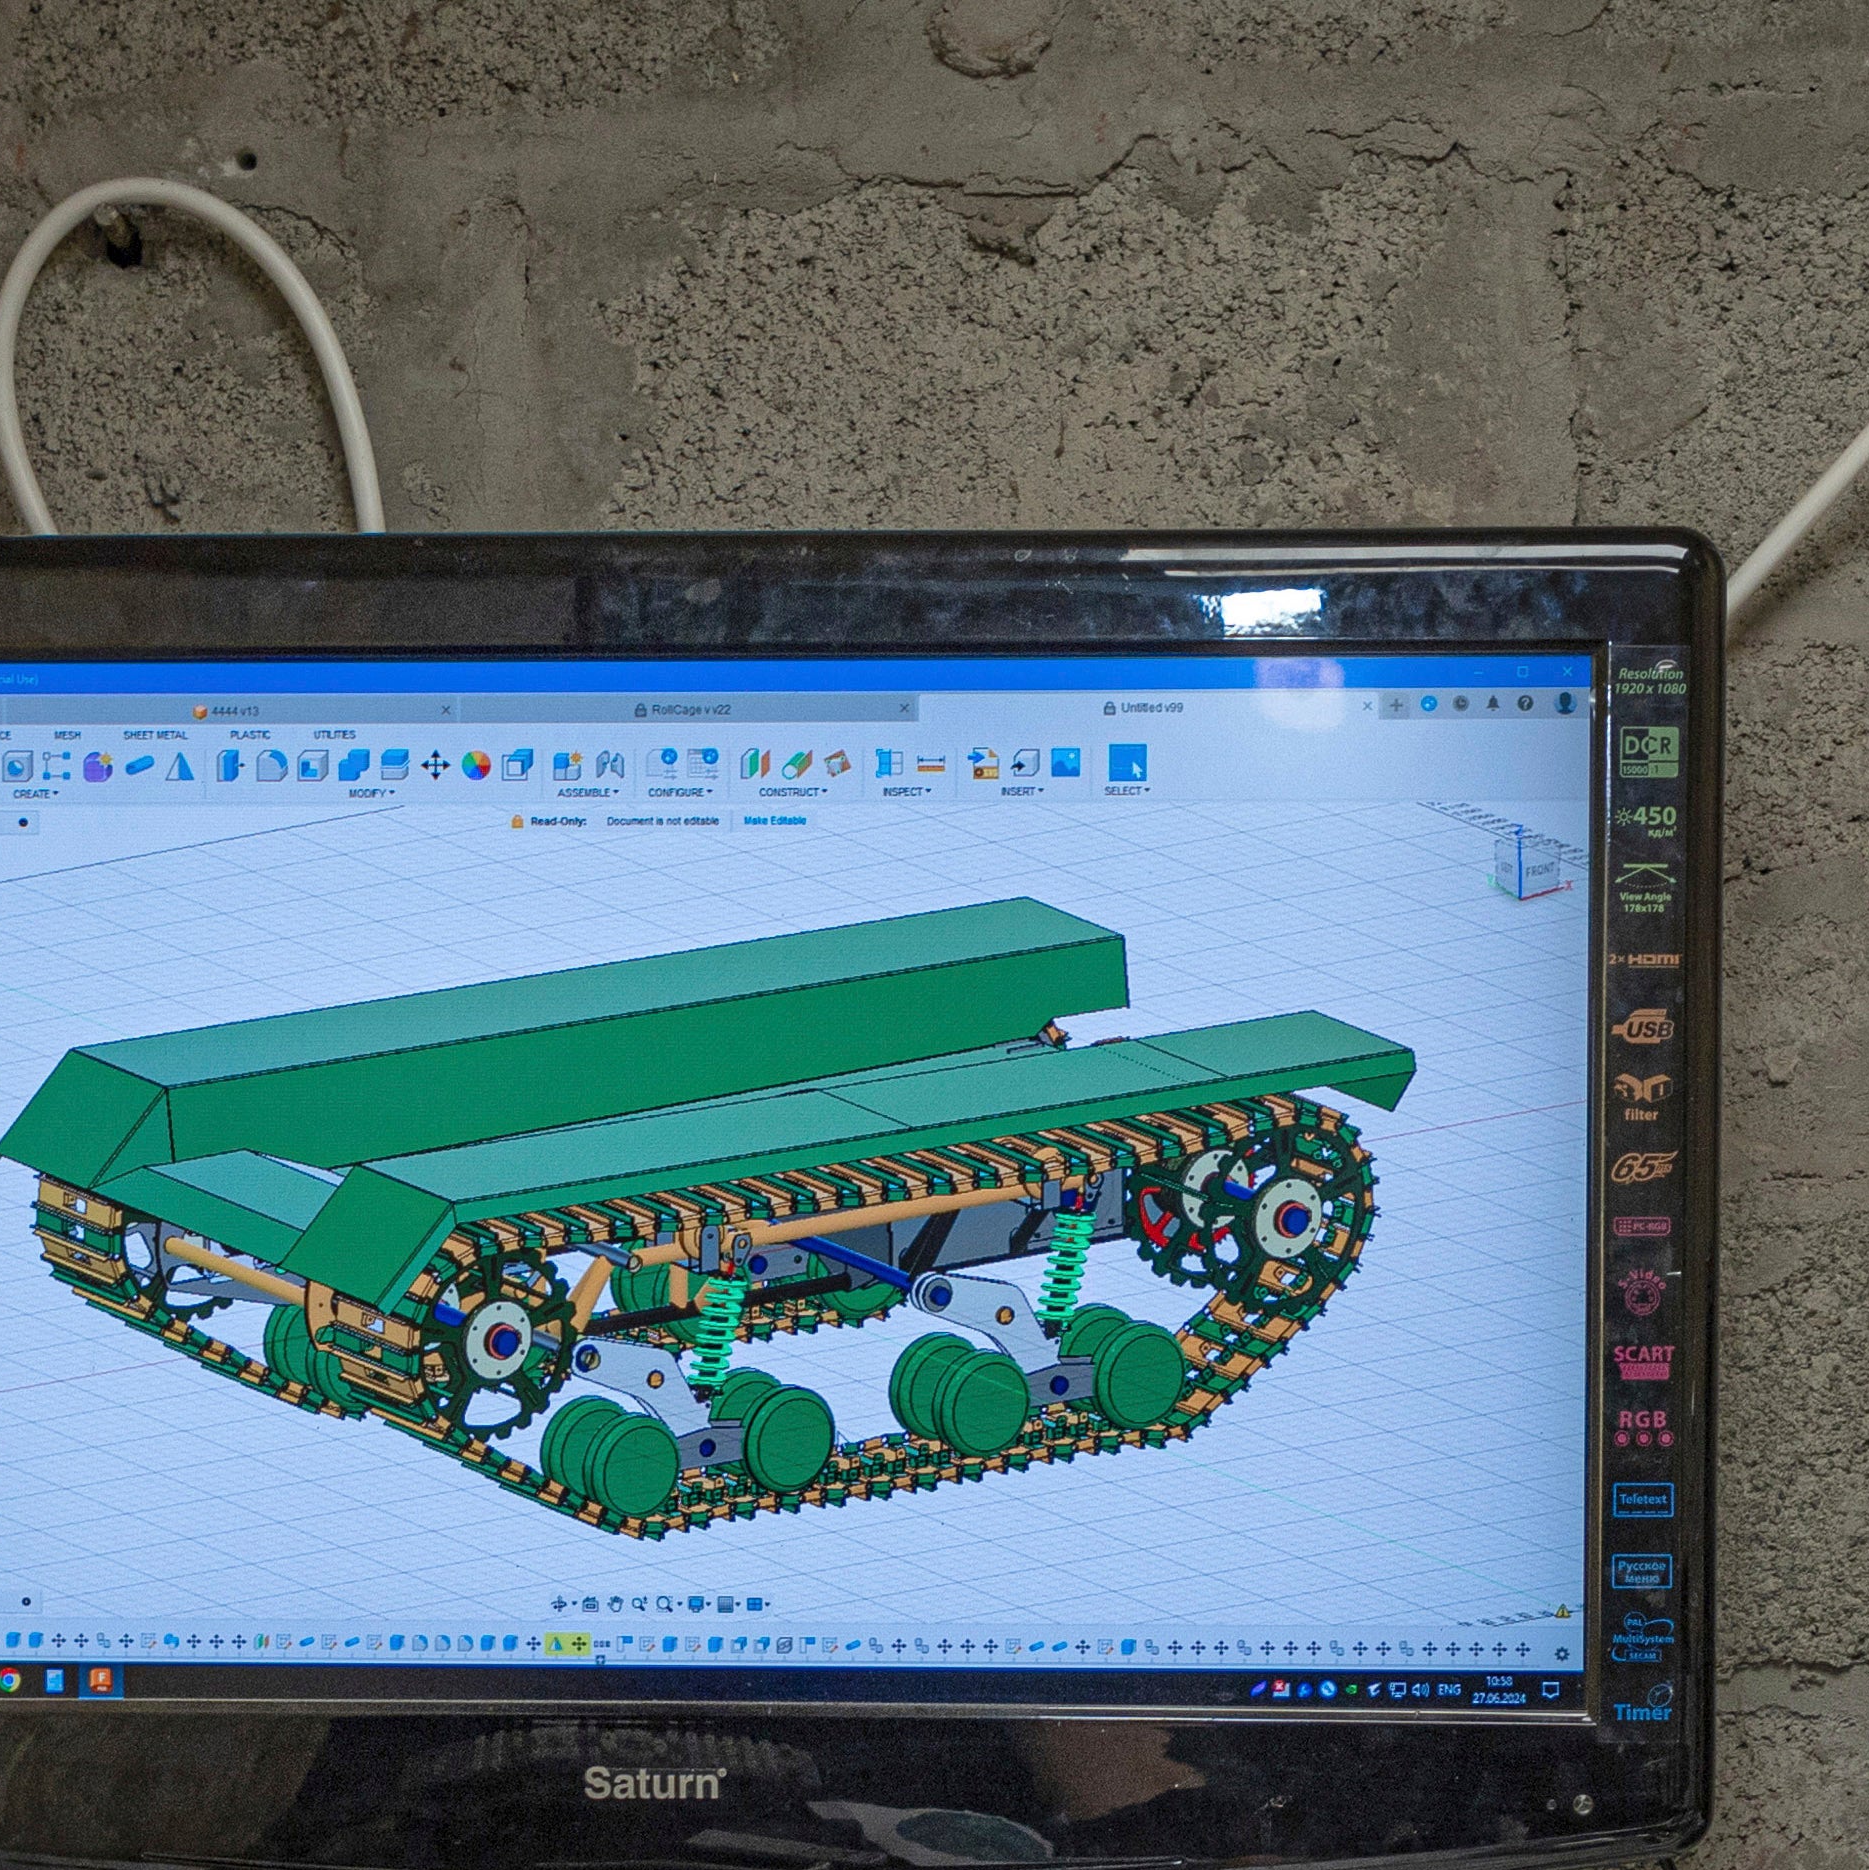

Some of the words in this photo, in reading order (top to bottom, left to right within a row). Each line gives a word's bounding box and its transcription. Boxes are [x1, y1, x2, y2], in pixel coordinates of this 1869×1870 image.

[1619, 668, 1684, 680] Resolution
[1615, 683, 1644, 694] 1920
[1646, 686, 1652, 694] x
[1658, 683, 1687, 694] 1080
[212, 706, 237, 716] 4444
[240, 706, 260, 716] v13
[652, 704, 702, 716] RollCage
[712, 705, 731, 715] v22
[1121, 702, 1162, 713] Untitled
[1164, 703, 1184, 713] v99
[55, 731, 81, 741] MESH
[124, 730, 154, 740] SHEET
[157, 730, 188, 740] METAL
[230, 730, 270, 740] PLASTIC
[314, 730, 356, 740] UTILITIES
[1625, 736, 1672, 754] DCR
[14, 789, 50, 800] CREATE
[350, 788, 385, 798] MODIFY
[558, 788, 611, 798] ASSEMBLE
[648, 788, 704, 798] CONFIGURE
[760, 788, 820, 797] CONSTRUCT
[883, 787, 923, 797] INSPECT
[1001, 787, 1035, 797] INSERT
[1105, 786, 1142, 796] SELECT
[744, 816, 768, 826] Make
[770, 816, 806, 826] Editable
[1633, 807, 1677, 825] 450
[531, 816, 587, 828] Read-Only:
[607, 816, 654, 826] Document
[656, 816, 664, 826] is
[667, 817, 681, 826] not
[684, 816, 719, 826] editable
[1526, 862, 1555, 877] FRONT
[1620, 892, 1642, 902] View
[1644, 892, 1672, 903] Angle
[1624, 904, 1664, 912] 178x178
[1628, 954, 1680, 965] HDMI
[1628, 1022, 1674, 1038] USB
[1625, 1108, 1658, 1120] filter
[1614, 1346, 1676, 1362] SCART
[1619, 1411, 1666, 1428] RGB
[1619, 1493, 1667, 1504] Teletext
[1618, 1560, 1666, 1572] Русское
[1613, 1634, 1675, 1648] MultiSystem
[1437, 1684, 1462, 1696] ENG
[1613, 1704, 1672, 1720] Timer
[584, 1766, 718, 1800] Saturn
